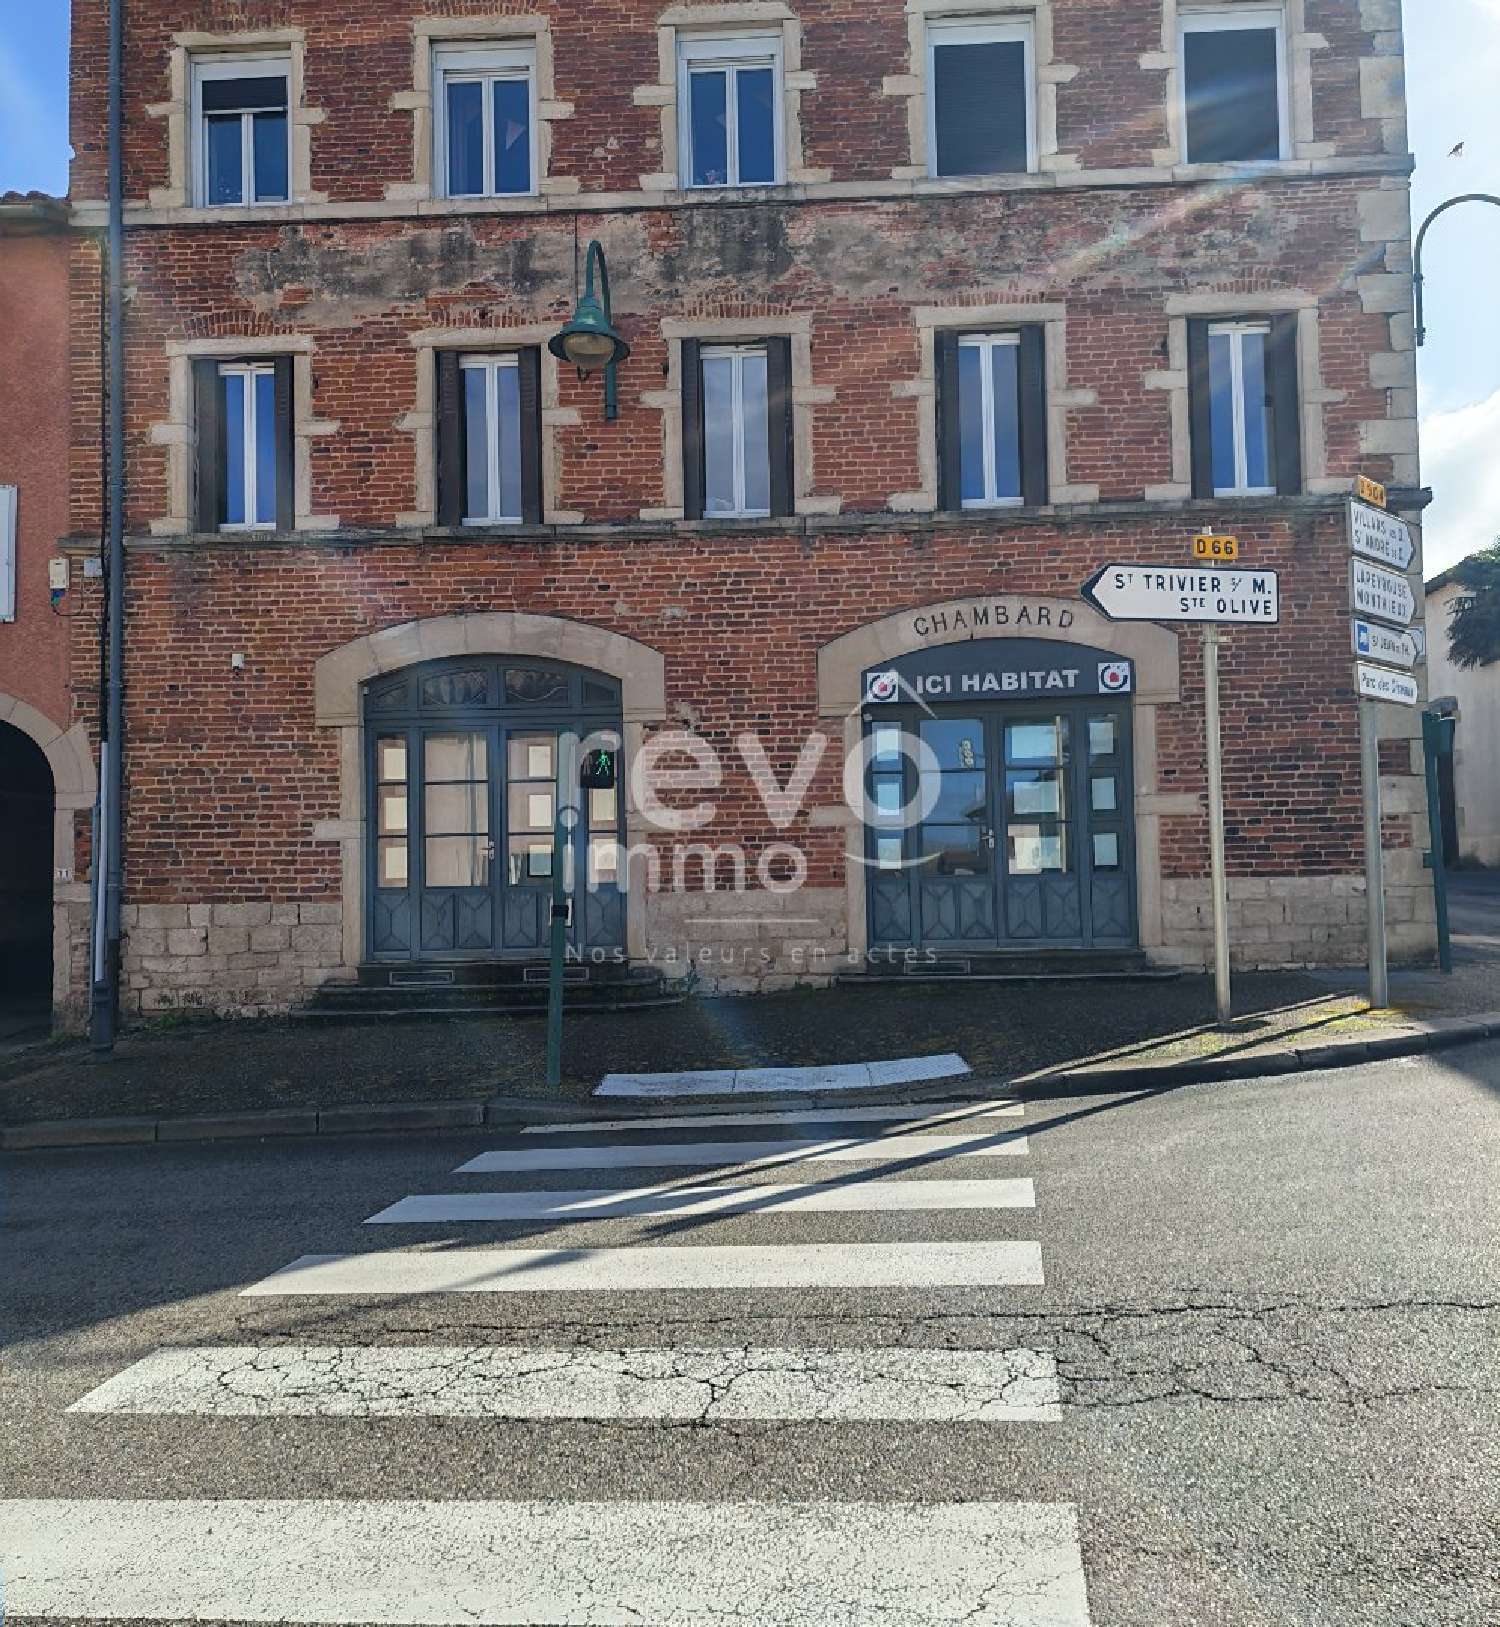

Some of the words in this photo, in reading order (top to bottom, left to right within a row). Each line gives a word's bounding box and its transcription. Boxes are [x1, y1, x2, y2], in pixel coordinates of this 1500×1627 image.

[1196, 538, 1206, 554] D
[1211, 540, 1234, 555] 66
[1143, 574, 1221, 593] TRIVIER
[1252, 577, 1272, 595] M.
[1216, 599, 1272, 616] OLIVE
[913, 605, 1074, 636] CHAMBARD
[916, 675, 951, 694] ICI
[961, 669, 1080, 693] HABITAT
